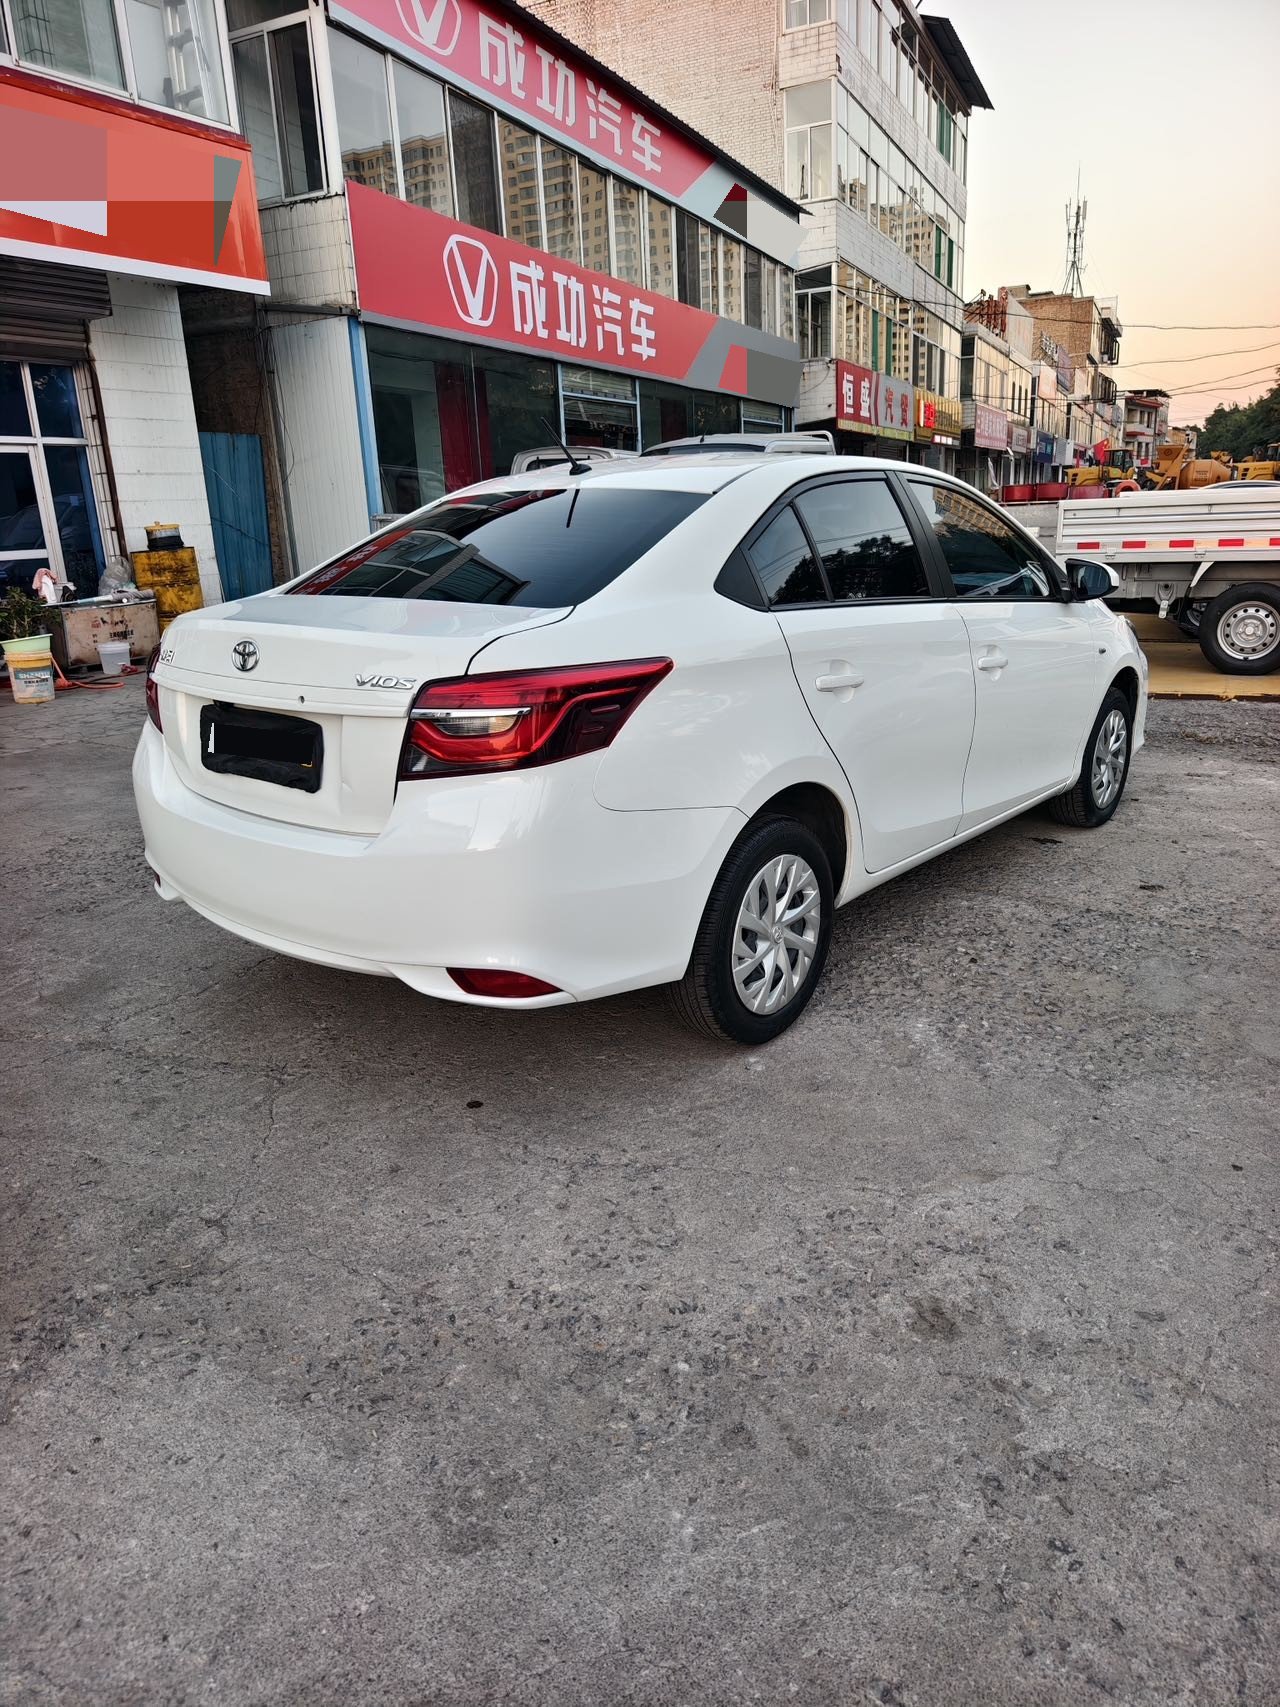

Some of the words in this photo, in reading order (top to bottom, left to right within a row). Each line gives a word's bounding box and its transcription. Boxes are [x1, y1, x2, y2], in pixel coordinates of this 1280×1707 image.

[478, 12, 662, 174] 成功汽车
[509, 260, 657, 361] 成功汽车
[356, 674, 417, 689] VIOS
